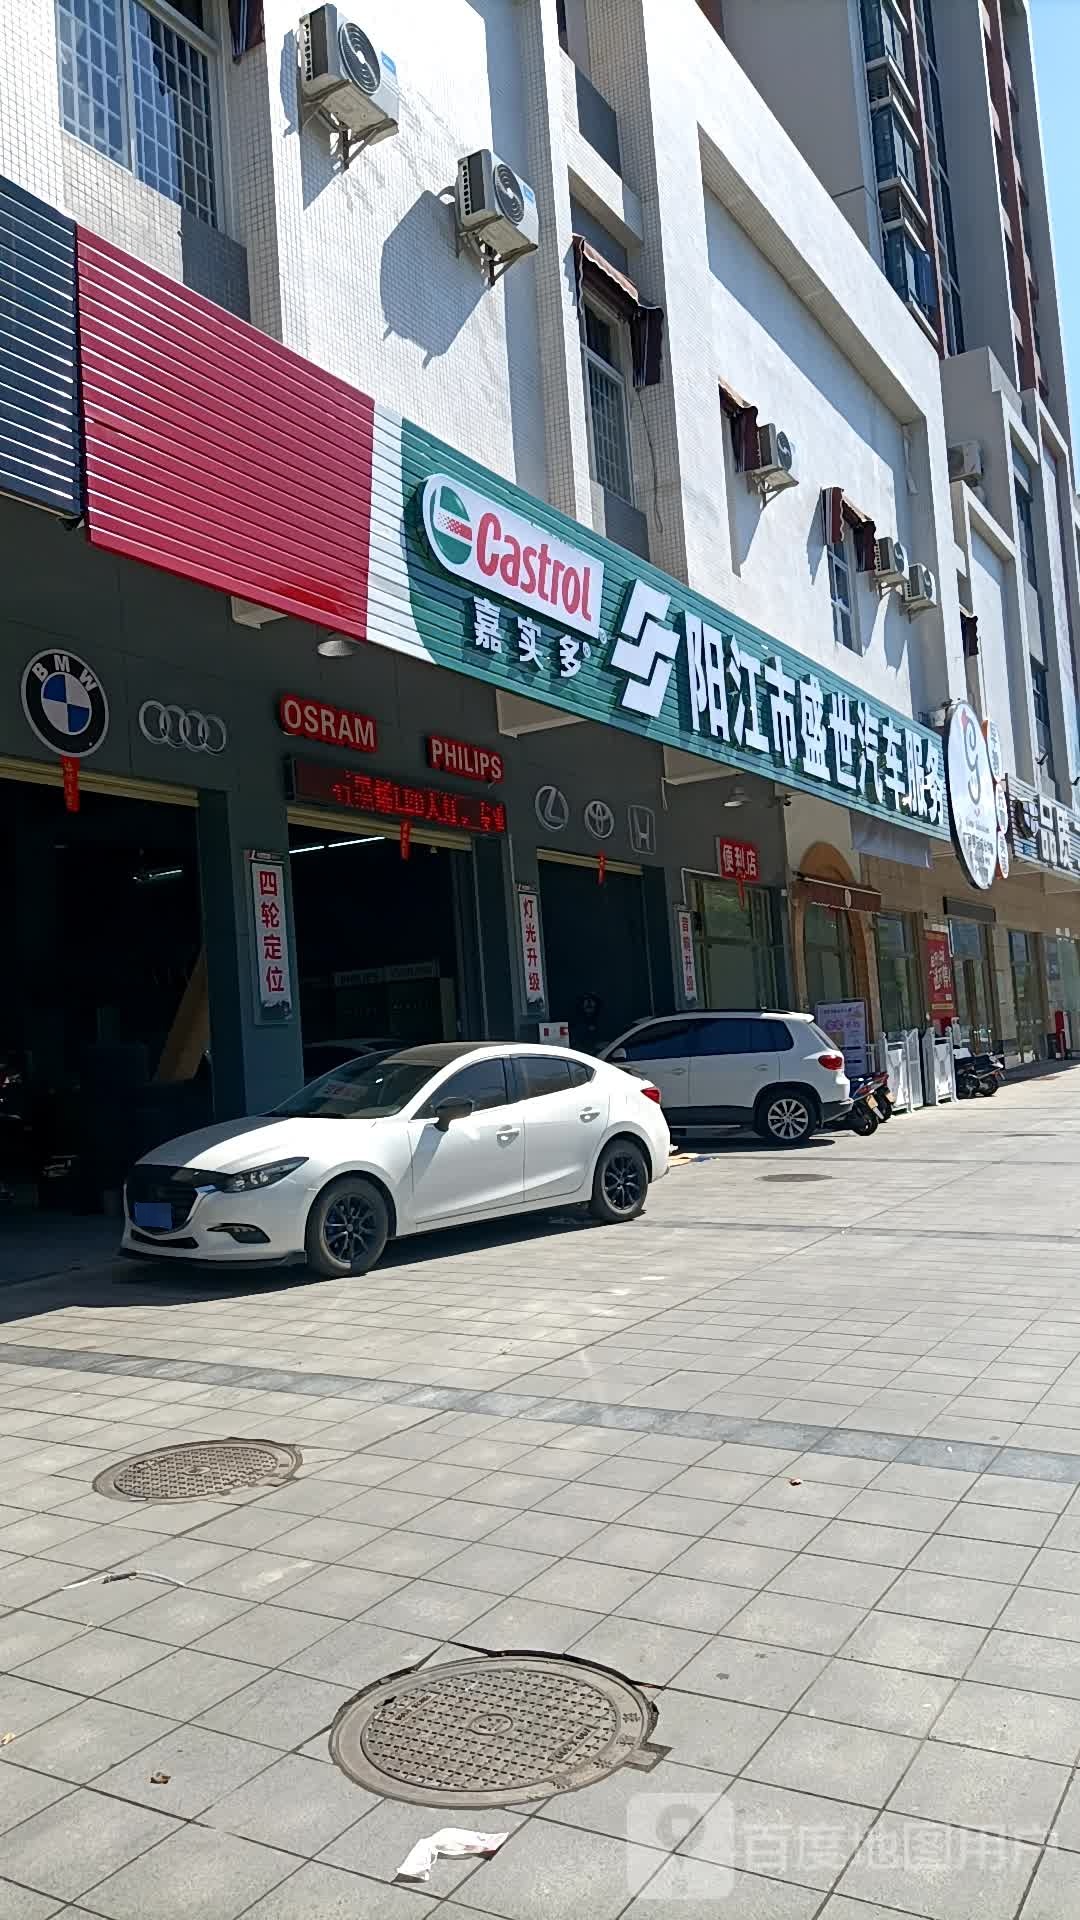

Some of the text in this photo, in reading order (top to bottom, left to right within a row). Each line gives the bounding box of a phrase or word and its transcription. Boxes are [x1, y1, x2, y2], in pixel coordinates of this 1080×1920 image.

[476, 512, 592, 623] Castrol
[31, 654, 98, 692] BMW
[473, 595, 582, 678] 嘉实多
[283, 699, 376, 748] OSRAM
[431, 737, 502, 779] PHILIPS
[684, 609, 945, 826] 阳江市盛世汽车服务
[722, 844, 758, 877] 便利店
[259, 870, 285, 993] 四轮定位
[523, 897, 541, 992] 灯光升级
